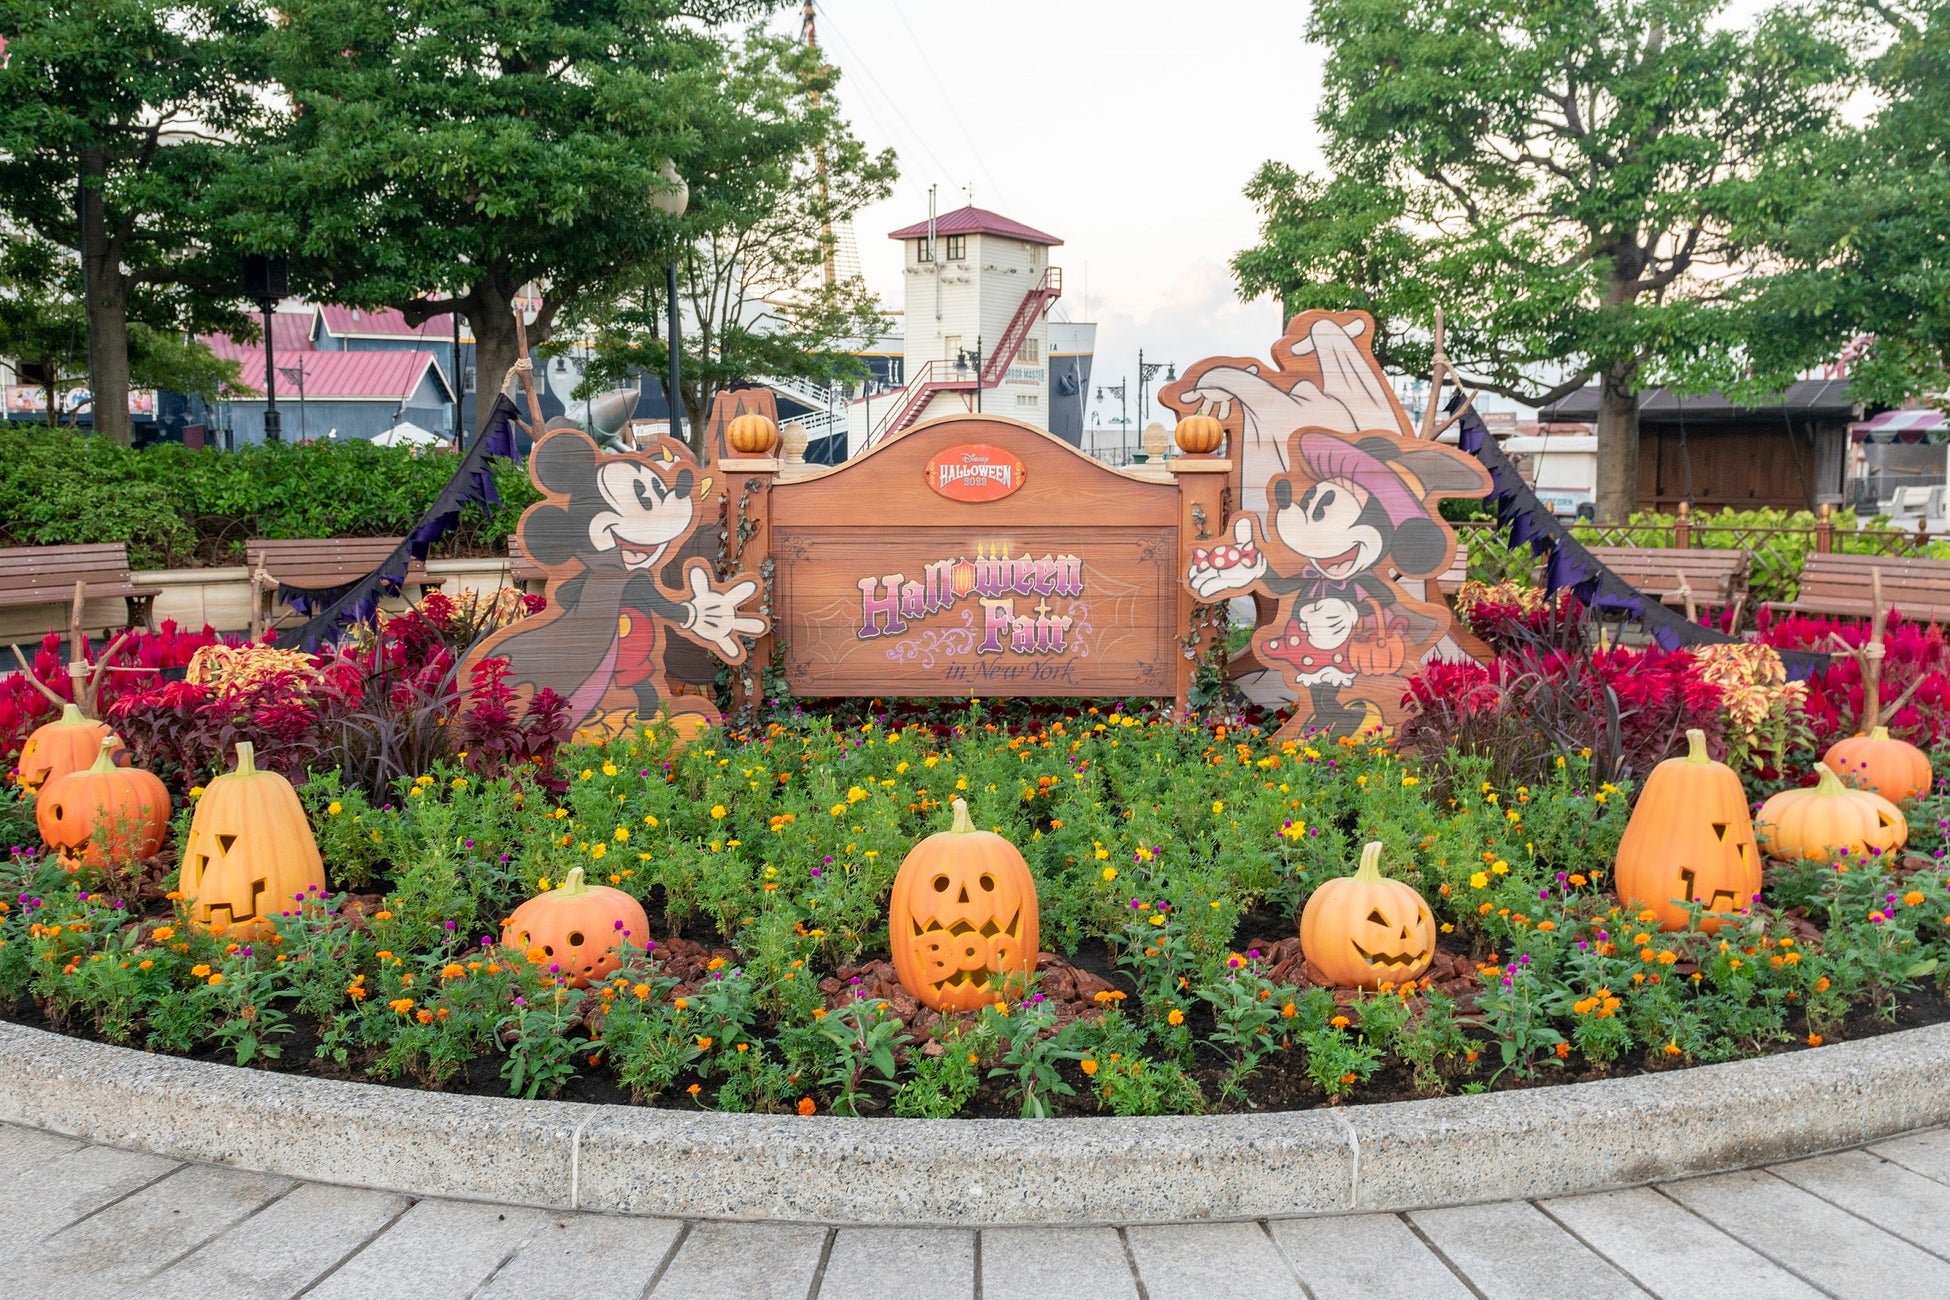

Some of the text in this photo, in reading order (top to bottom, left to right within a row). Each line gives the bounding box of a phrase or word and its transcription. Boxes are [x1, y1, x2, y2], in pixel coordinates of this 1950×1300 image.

[1024, 368, 1045, 382] MASTER
[960, 453, 989, 465] Disney
[940, 464, 1011, 489] HALLOWEEN
[963, 477, 988, 487] 2023
[857, 553, 1084, 639] Halloween
[976, 597, 1073, 655] Fair
[944, 656, 1080, 685] in New York
[911, 929, 1021, 984] BOO
